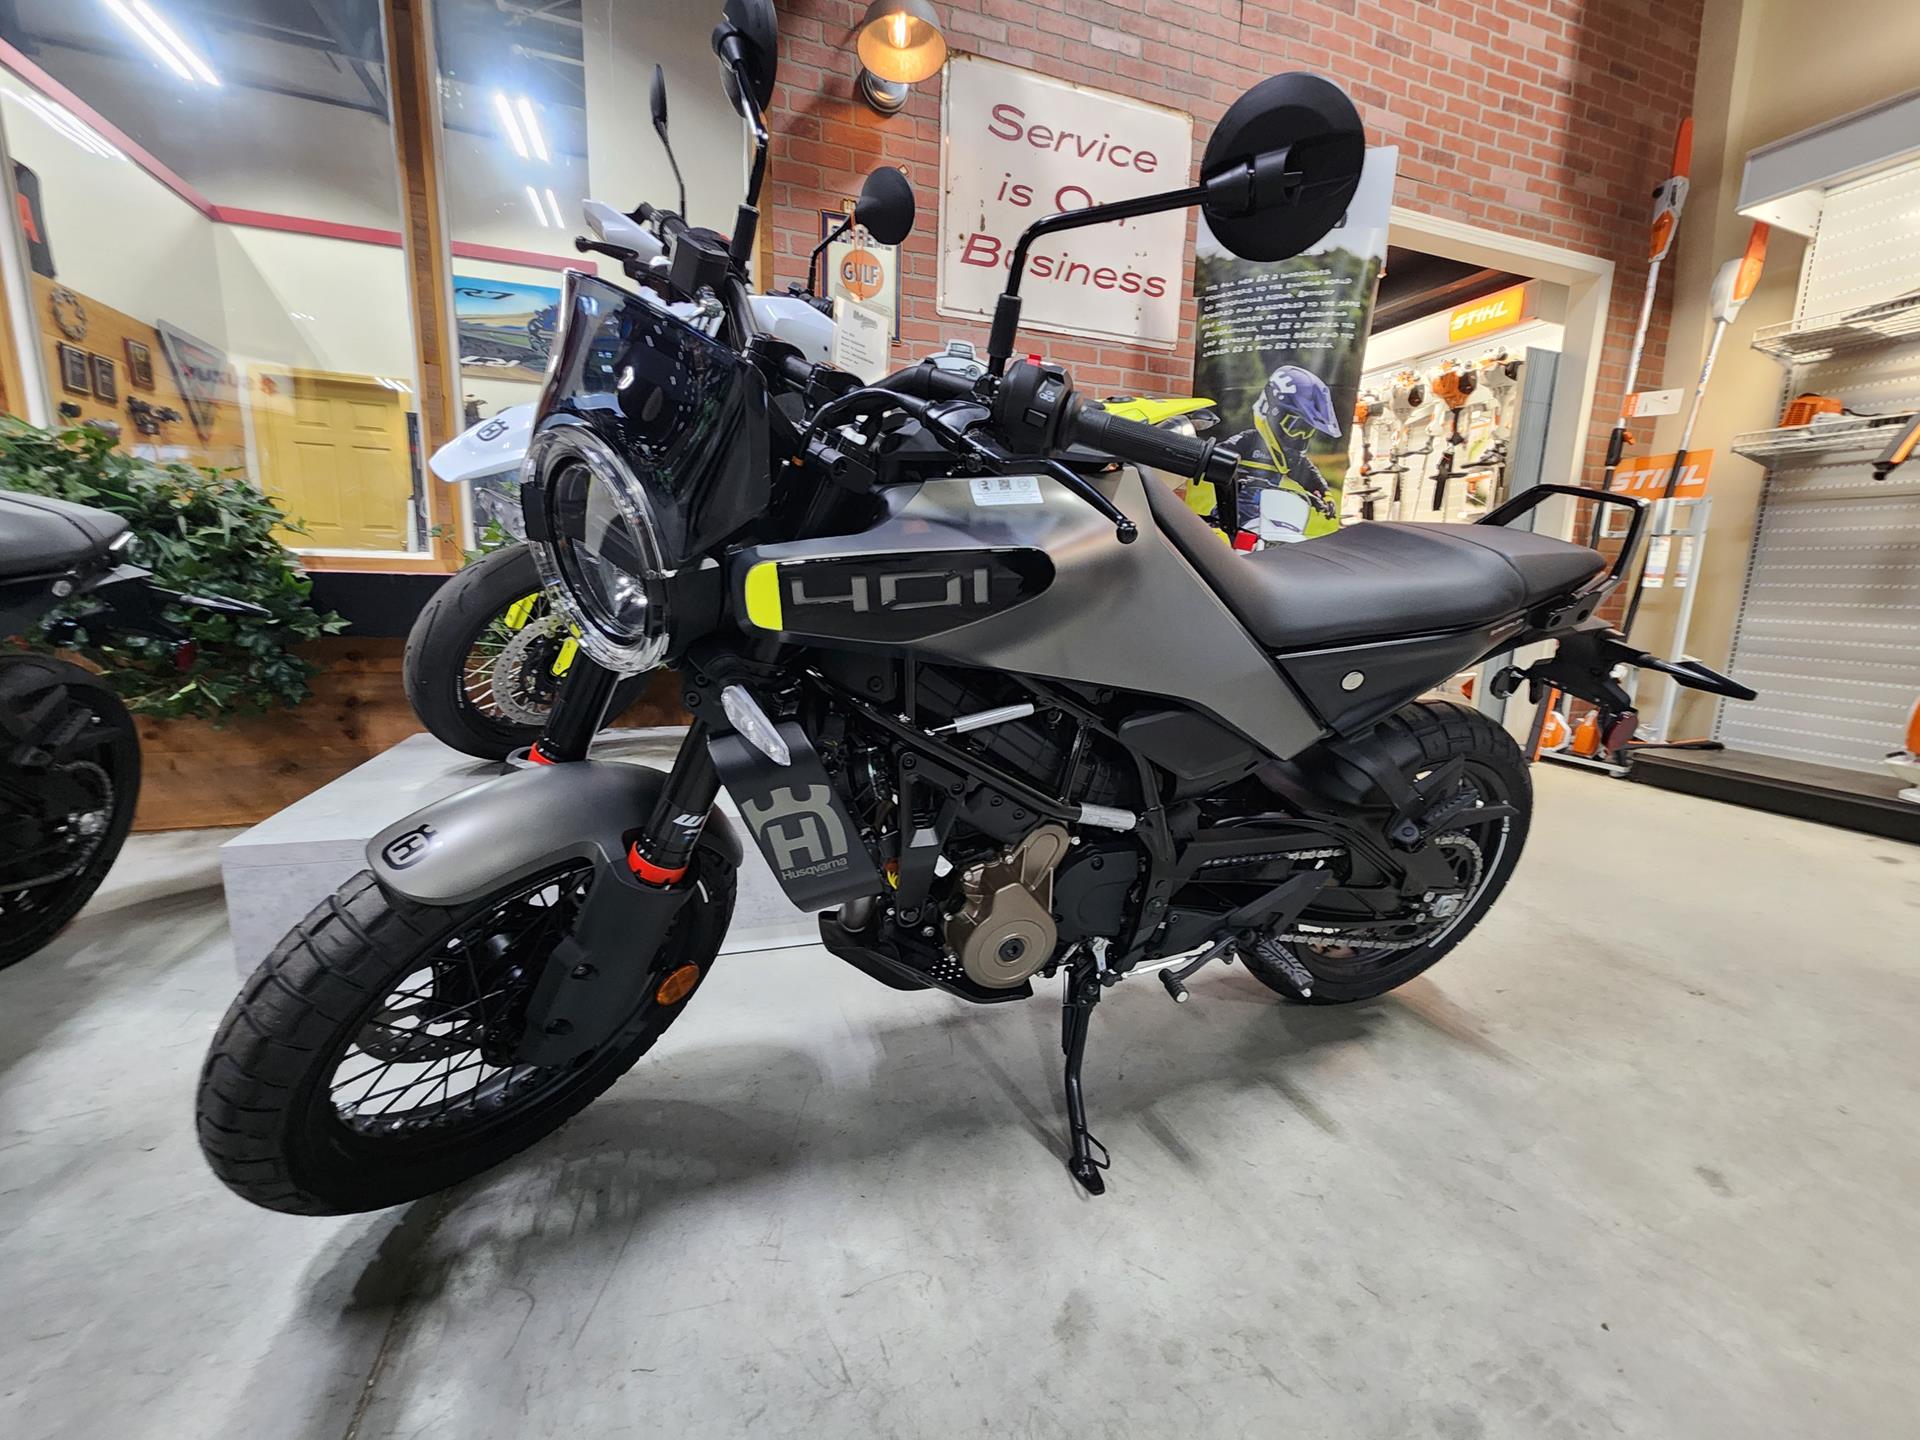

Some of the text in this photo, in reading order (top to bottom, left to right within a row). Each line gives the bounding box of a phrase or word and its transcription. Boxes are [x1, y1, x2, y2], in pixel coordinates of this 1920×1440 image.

[988, 104, 1158, 173] Service
[997, 172, 1034, 207] is
[1450, 300, 1509, 332] STIHL
[1609, 464, 1705, 492] STIHL
[791, 568, 989, 612] 401
[781, 857, 848, 881] Husqvarna
